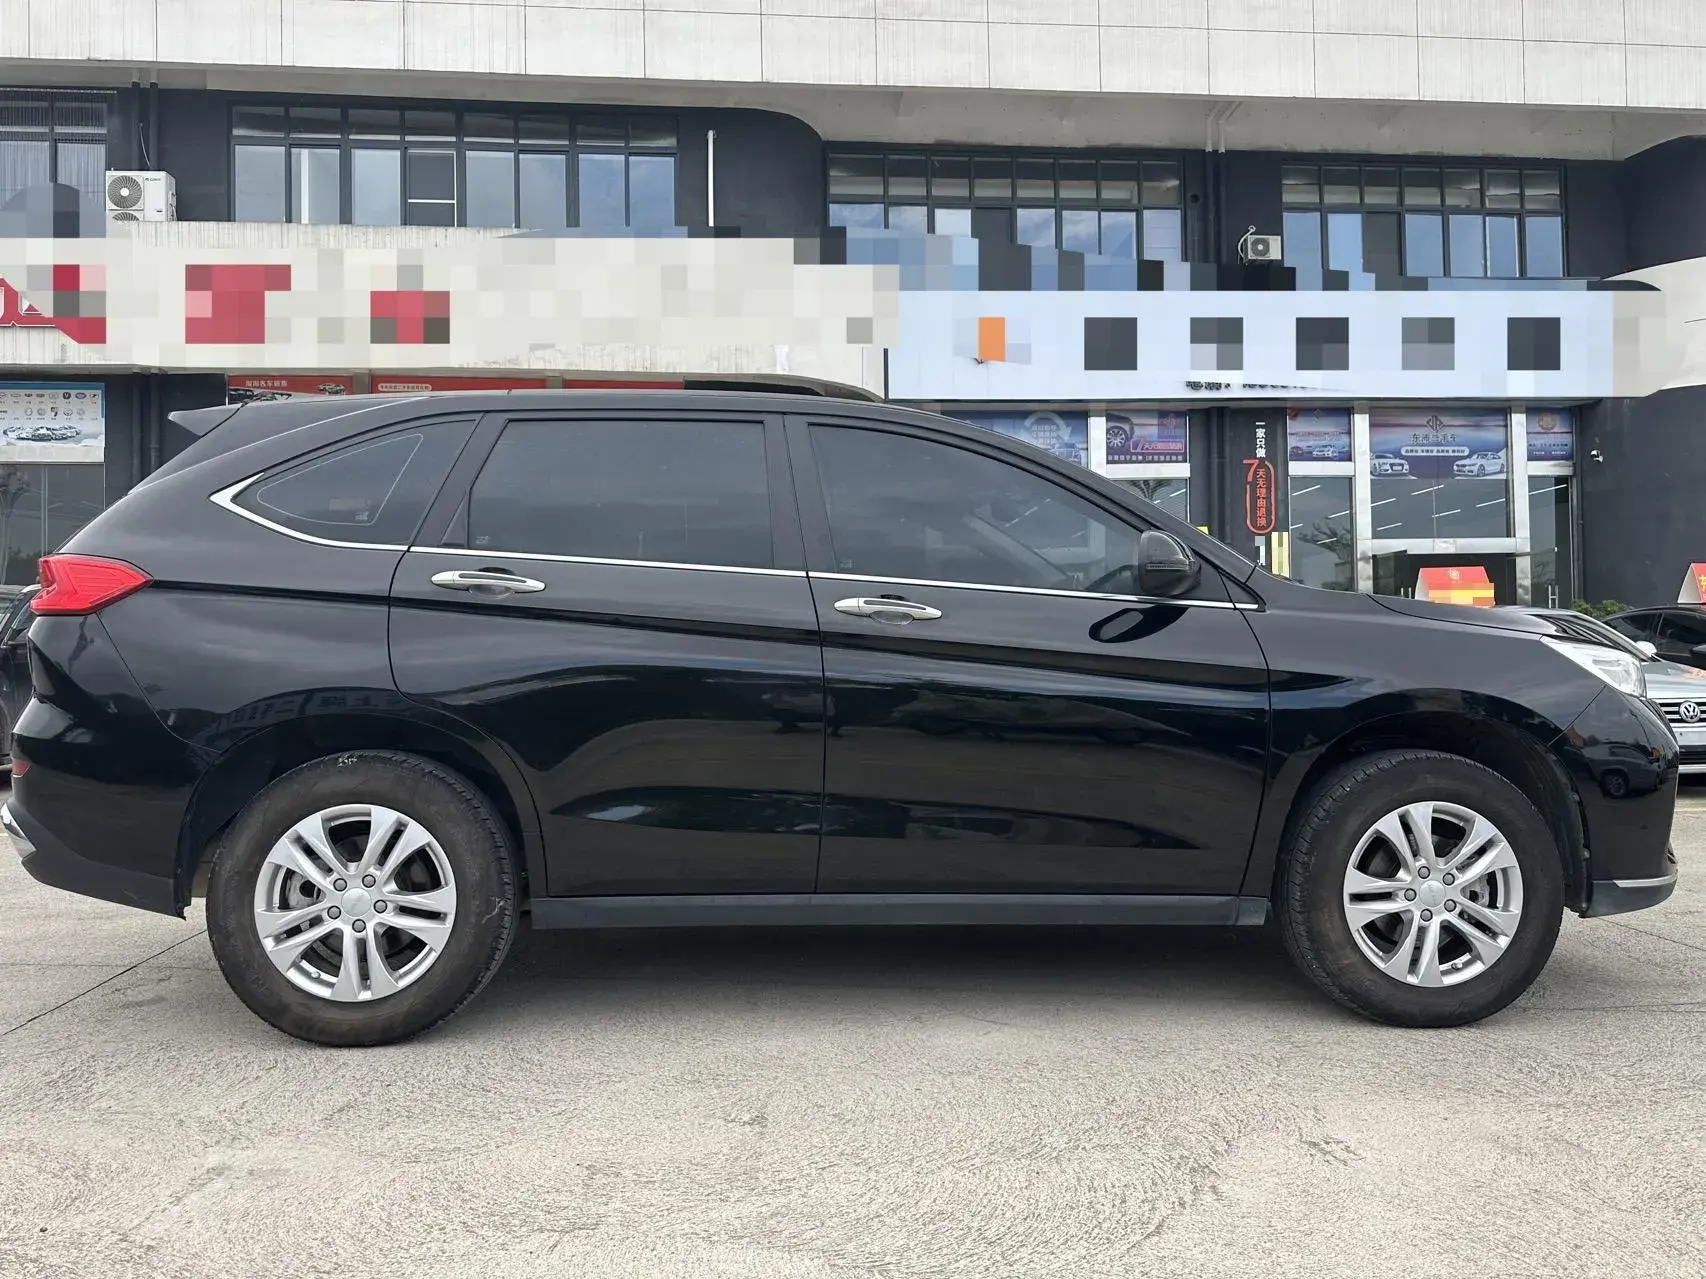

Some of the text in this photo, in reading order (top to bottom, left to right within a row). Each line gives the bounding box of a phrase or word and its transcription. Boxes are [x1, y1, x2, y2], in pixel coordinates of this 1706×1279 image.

[1255, 421, 1266, 458] 一家只做
[1256, 468, 1267, 527] 天无理由退换
